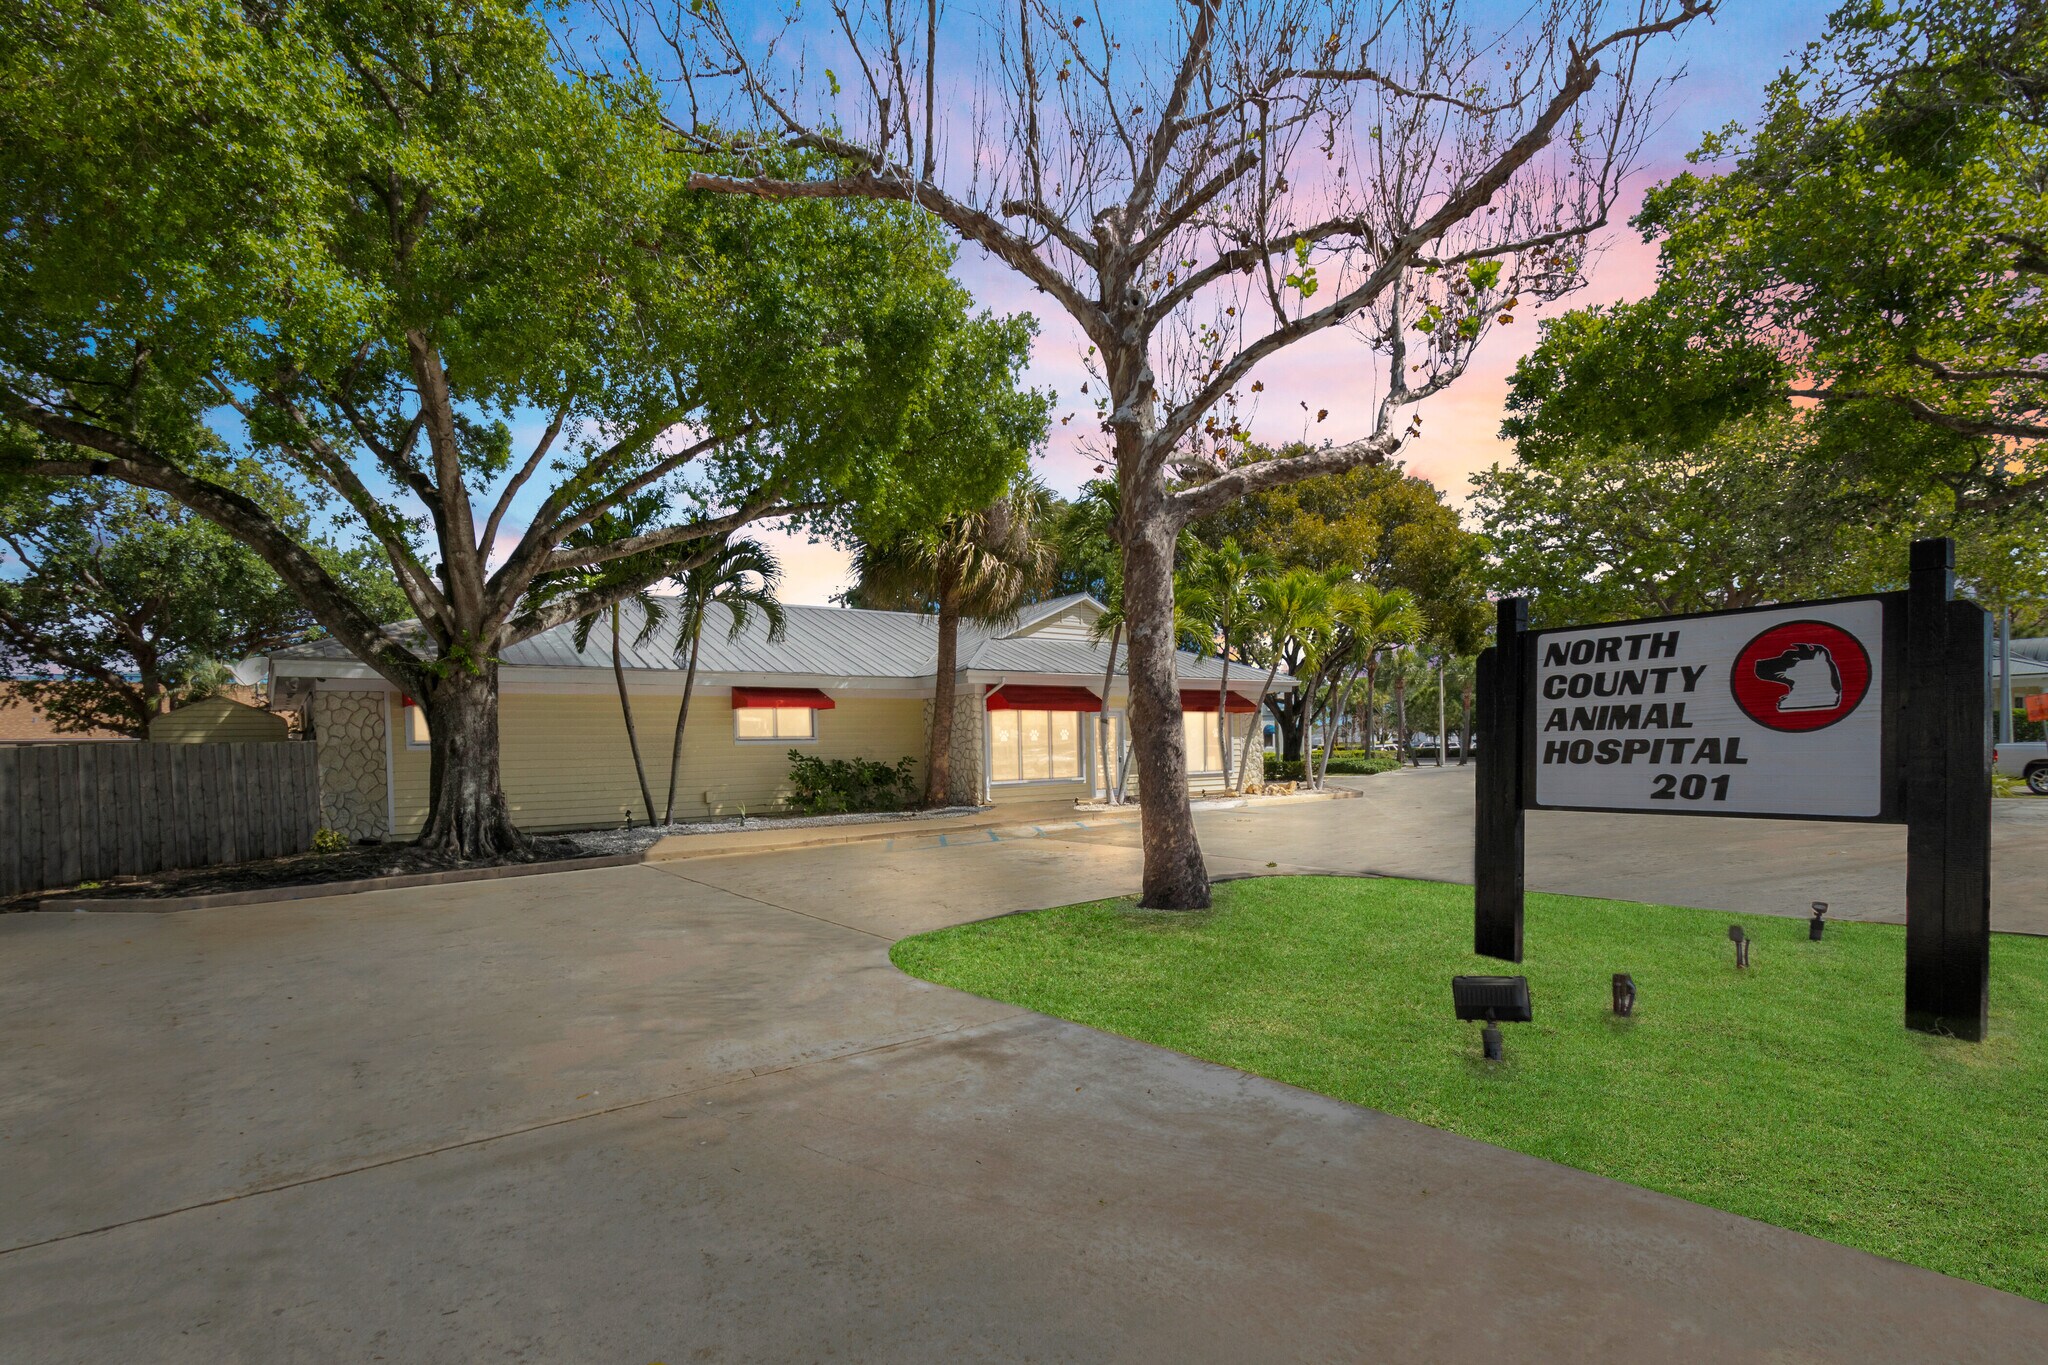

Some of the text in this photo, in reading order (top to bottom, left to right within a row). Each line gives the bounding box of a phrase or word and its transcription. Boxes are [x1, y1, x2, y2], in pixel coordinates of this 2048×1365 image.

[1543, 630, 1680, 667] NORTH
[1543, 664, 1707, 699] COUNTY
[1544, 702, 1693, 732] ANIMAL
[1543, 737, 1748, 764] HOSPITAL
[1650, 774, 1730, 801] 201
